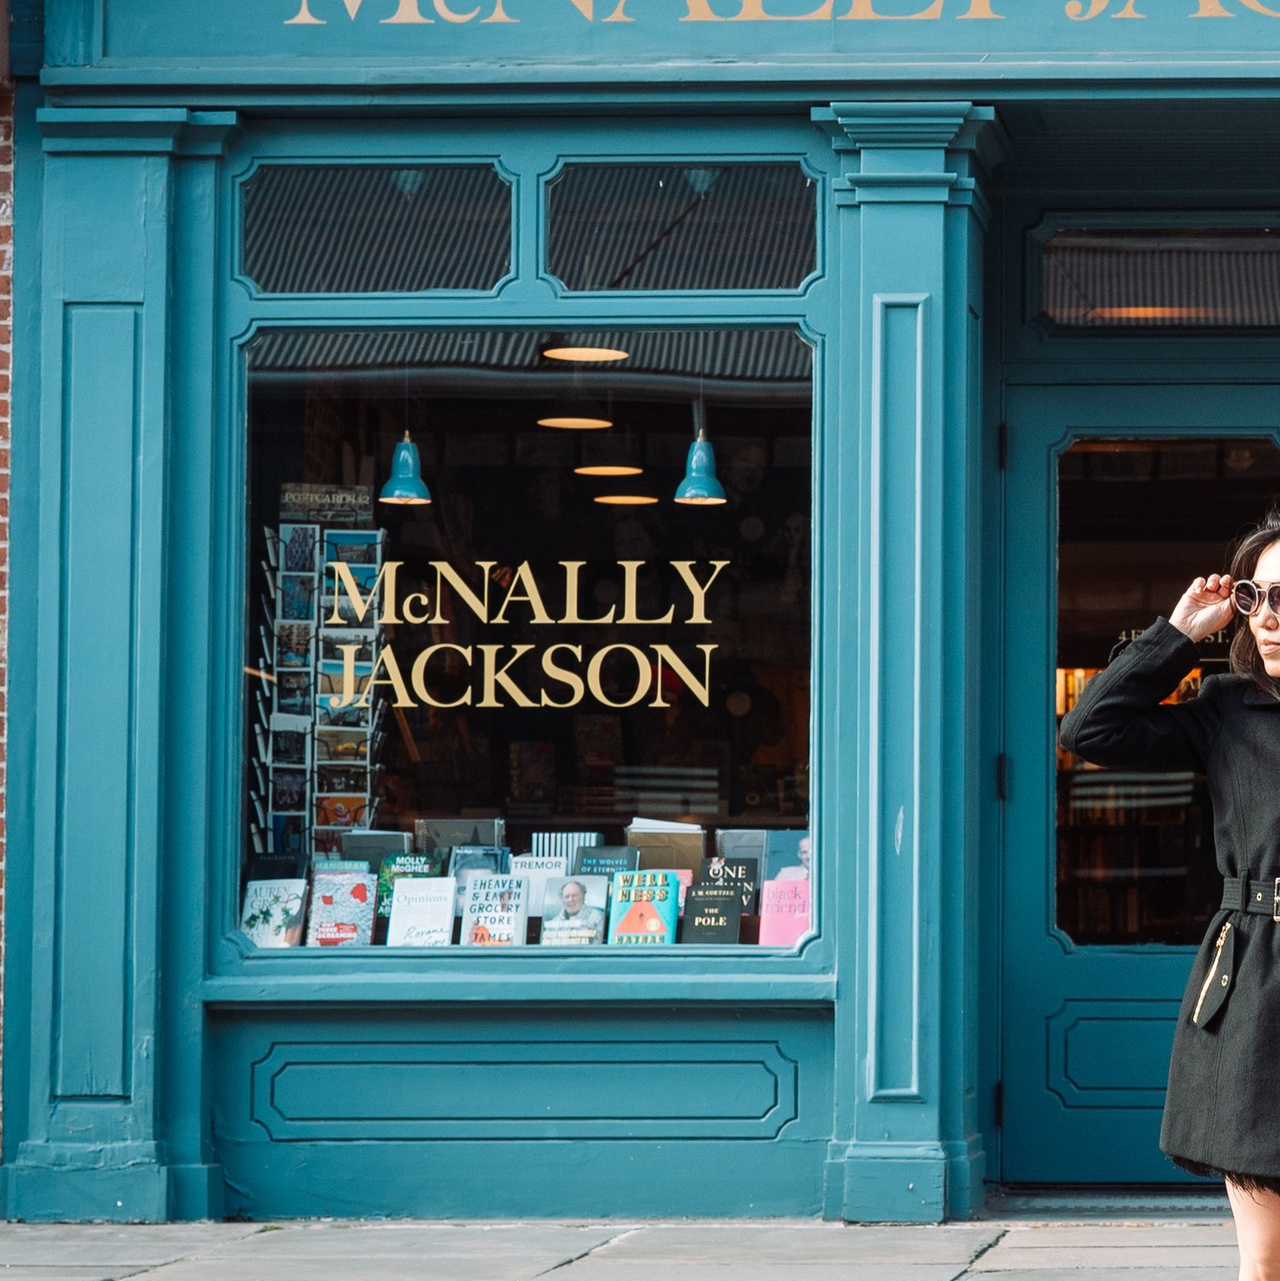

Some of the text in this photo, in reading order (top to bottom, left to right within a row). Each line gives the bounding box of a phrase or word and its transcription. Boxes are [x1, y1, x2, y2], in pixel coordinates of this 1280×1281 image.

[326, 559, 731, 624] McNALLY
[328, 643, 719, 708] JACKSON
[316, 862, 366, 870] HANGMAN
[395, 856, 427, 865] MOLLY
[513, 861, 562, 870] TREMOR
[390, 864, 430, 873] McGHEE
[708, 865, 746, 879] ONE
[480, 880, 522, 890] HEAVEN
[619, 874, 669, 888] WELL
[249, 885, 289, 896] AUREN
[472, 891, 521, 901] & EARTH
[618, 888, 669, 902] NESS
[766, 886, 802, 900] black
[397, 894, 448, 906] Opinions
[470, 903, 520, 914] GROCERY
[765, 900, 806, 914] friend
[474, 916, 512, 925] STORE
[694, 916, 728, 927] POLE
[472, 933, 512, 942] JAMES
